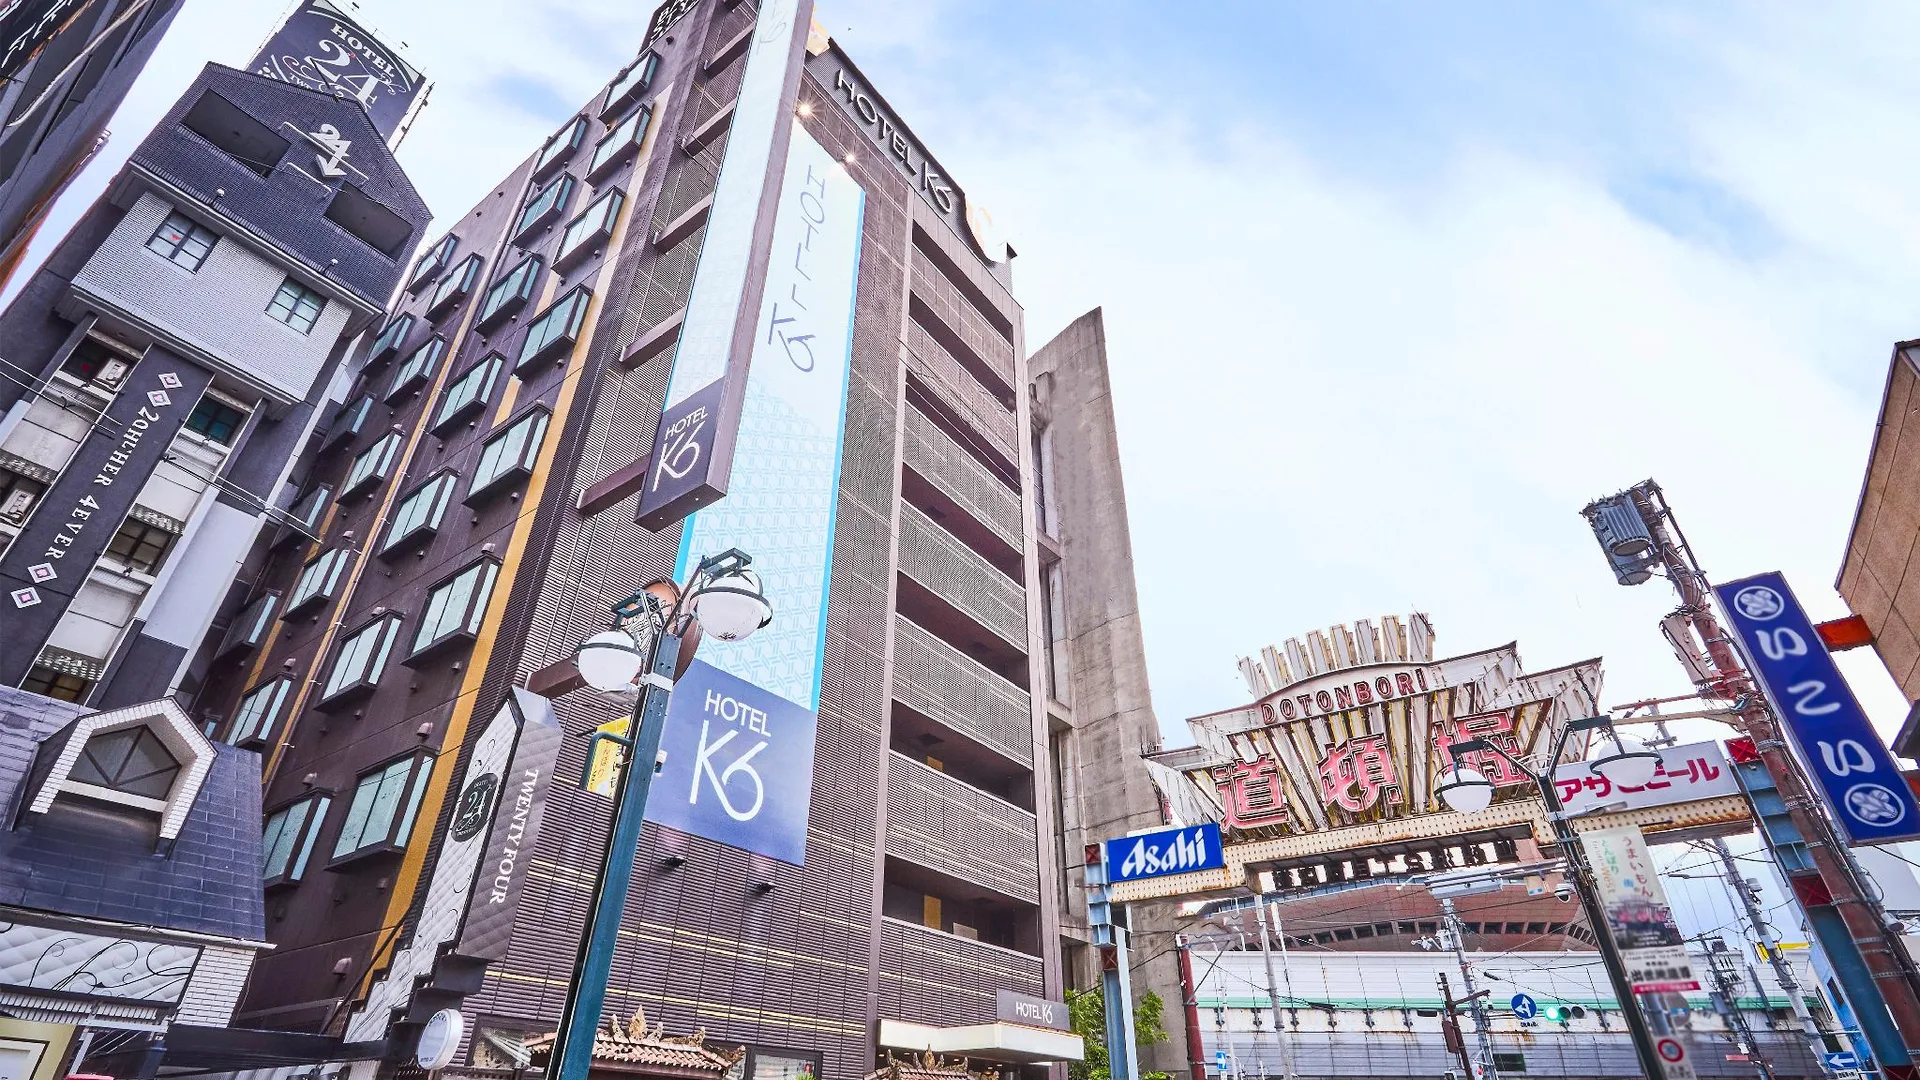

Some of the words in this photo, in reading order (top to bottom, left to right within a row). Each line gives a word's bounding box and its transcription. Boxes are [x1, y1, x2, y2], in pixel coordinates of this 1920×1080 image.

[306, 39, 379, 111] 24
[332, 23, 396, 79] HOTEL
[310, 124, 351, 178] 24
[838, 67, 918, 175] HOTEL
[924, 161, 952, 213] K6
[665, 405, 708, 441] HOTEL
[652, 420, 706, 492] K6
[44, 494, 100, 560] 4EVER
[704, 688, 772, 737] HOTEL
[1261, 667, 1430, 725] DOTONBORI
[689, 720, 769, 822] K6
[1213, 708, 1533, 833] 道頓堀
[508, 769, 540, 846] TWENTY
[490, 846, 518, 905] FOUR
[1121, 827, 1207, 878] Asahi
[1015, 1001, 1042, 1020] HOTEL
[1042, 1004, 1053, 1024] K6
